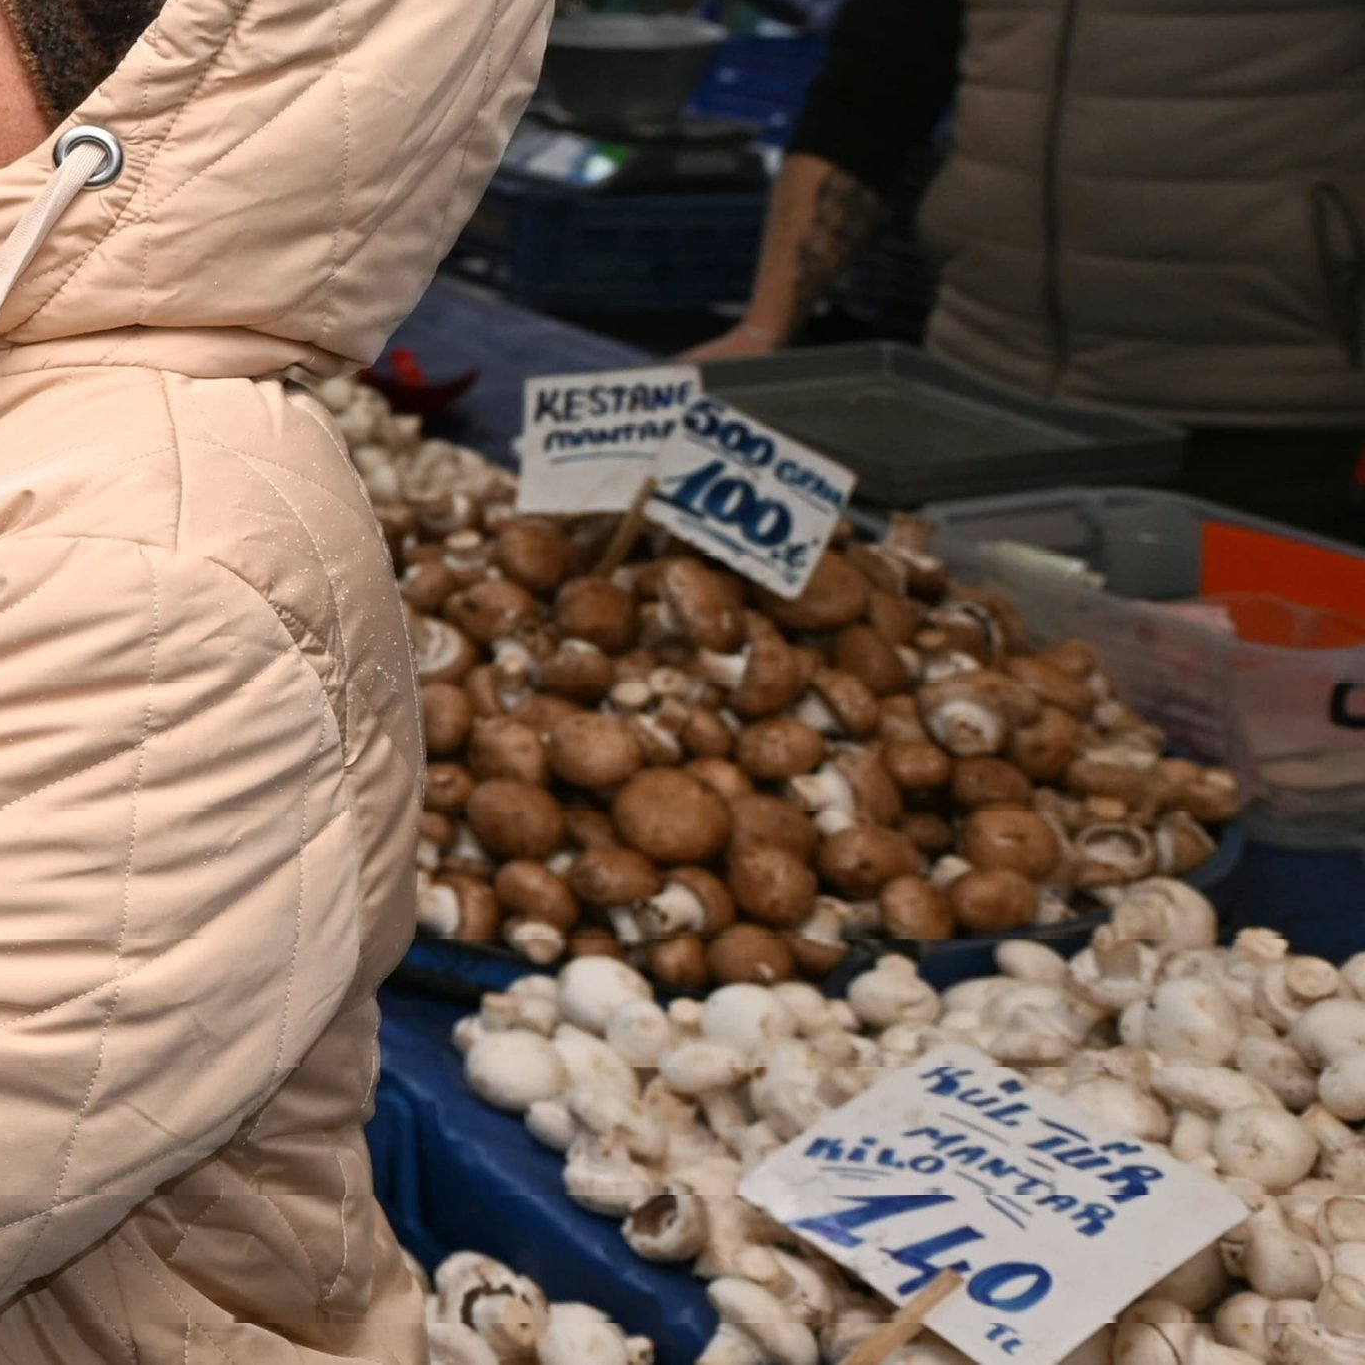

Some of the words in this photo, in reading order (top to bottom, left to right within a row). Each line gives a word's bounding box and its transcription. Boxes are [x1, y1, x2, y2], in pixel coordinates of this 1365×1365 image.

[683, 398, 775, 468] 500
[660, 459, 793, 548] 100
[903, 1125, 1116, 1237] MANTAR
[791, 1191, 1053, 1313] 140
